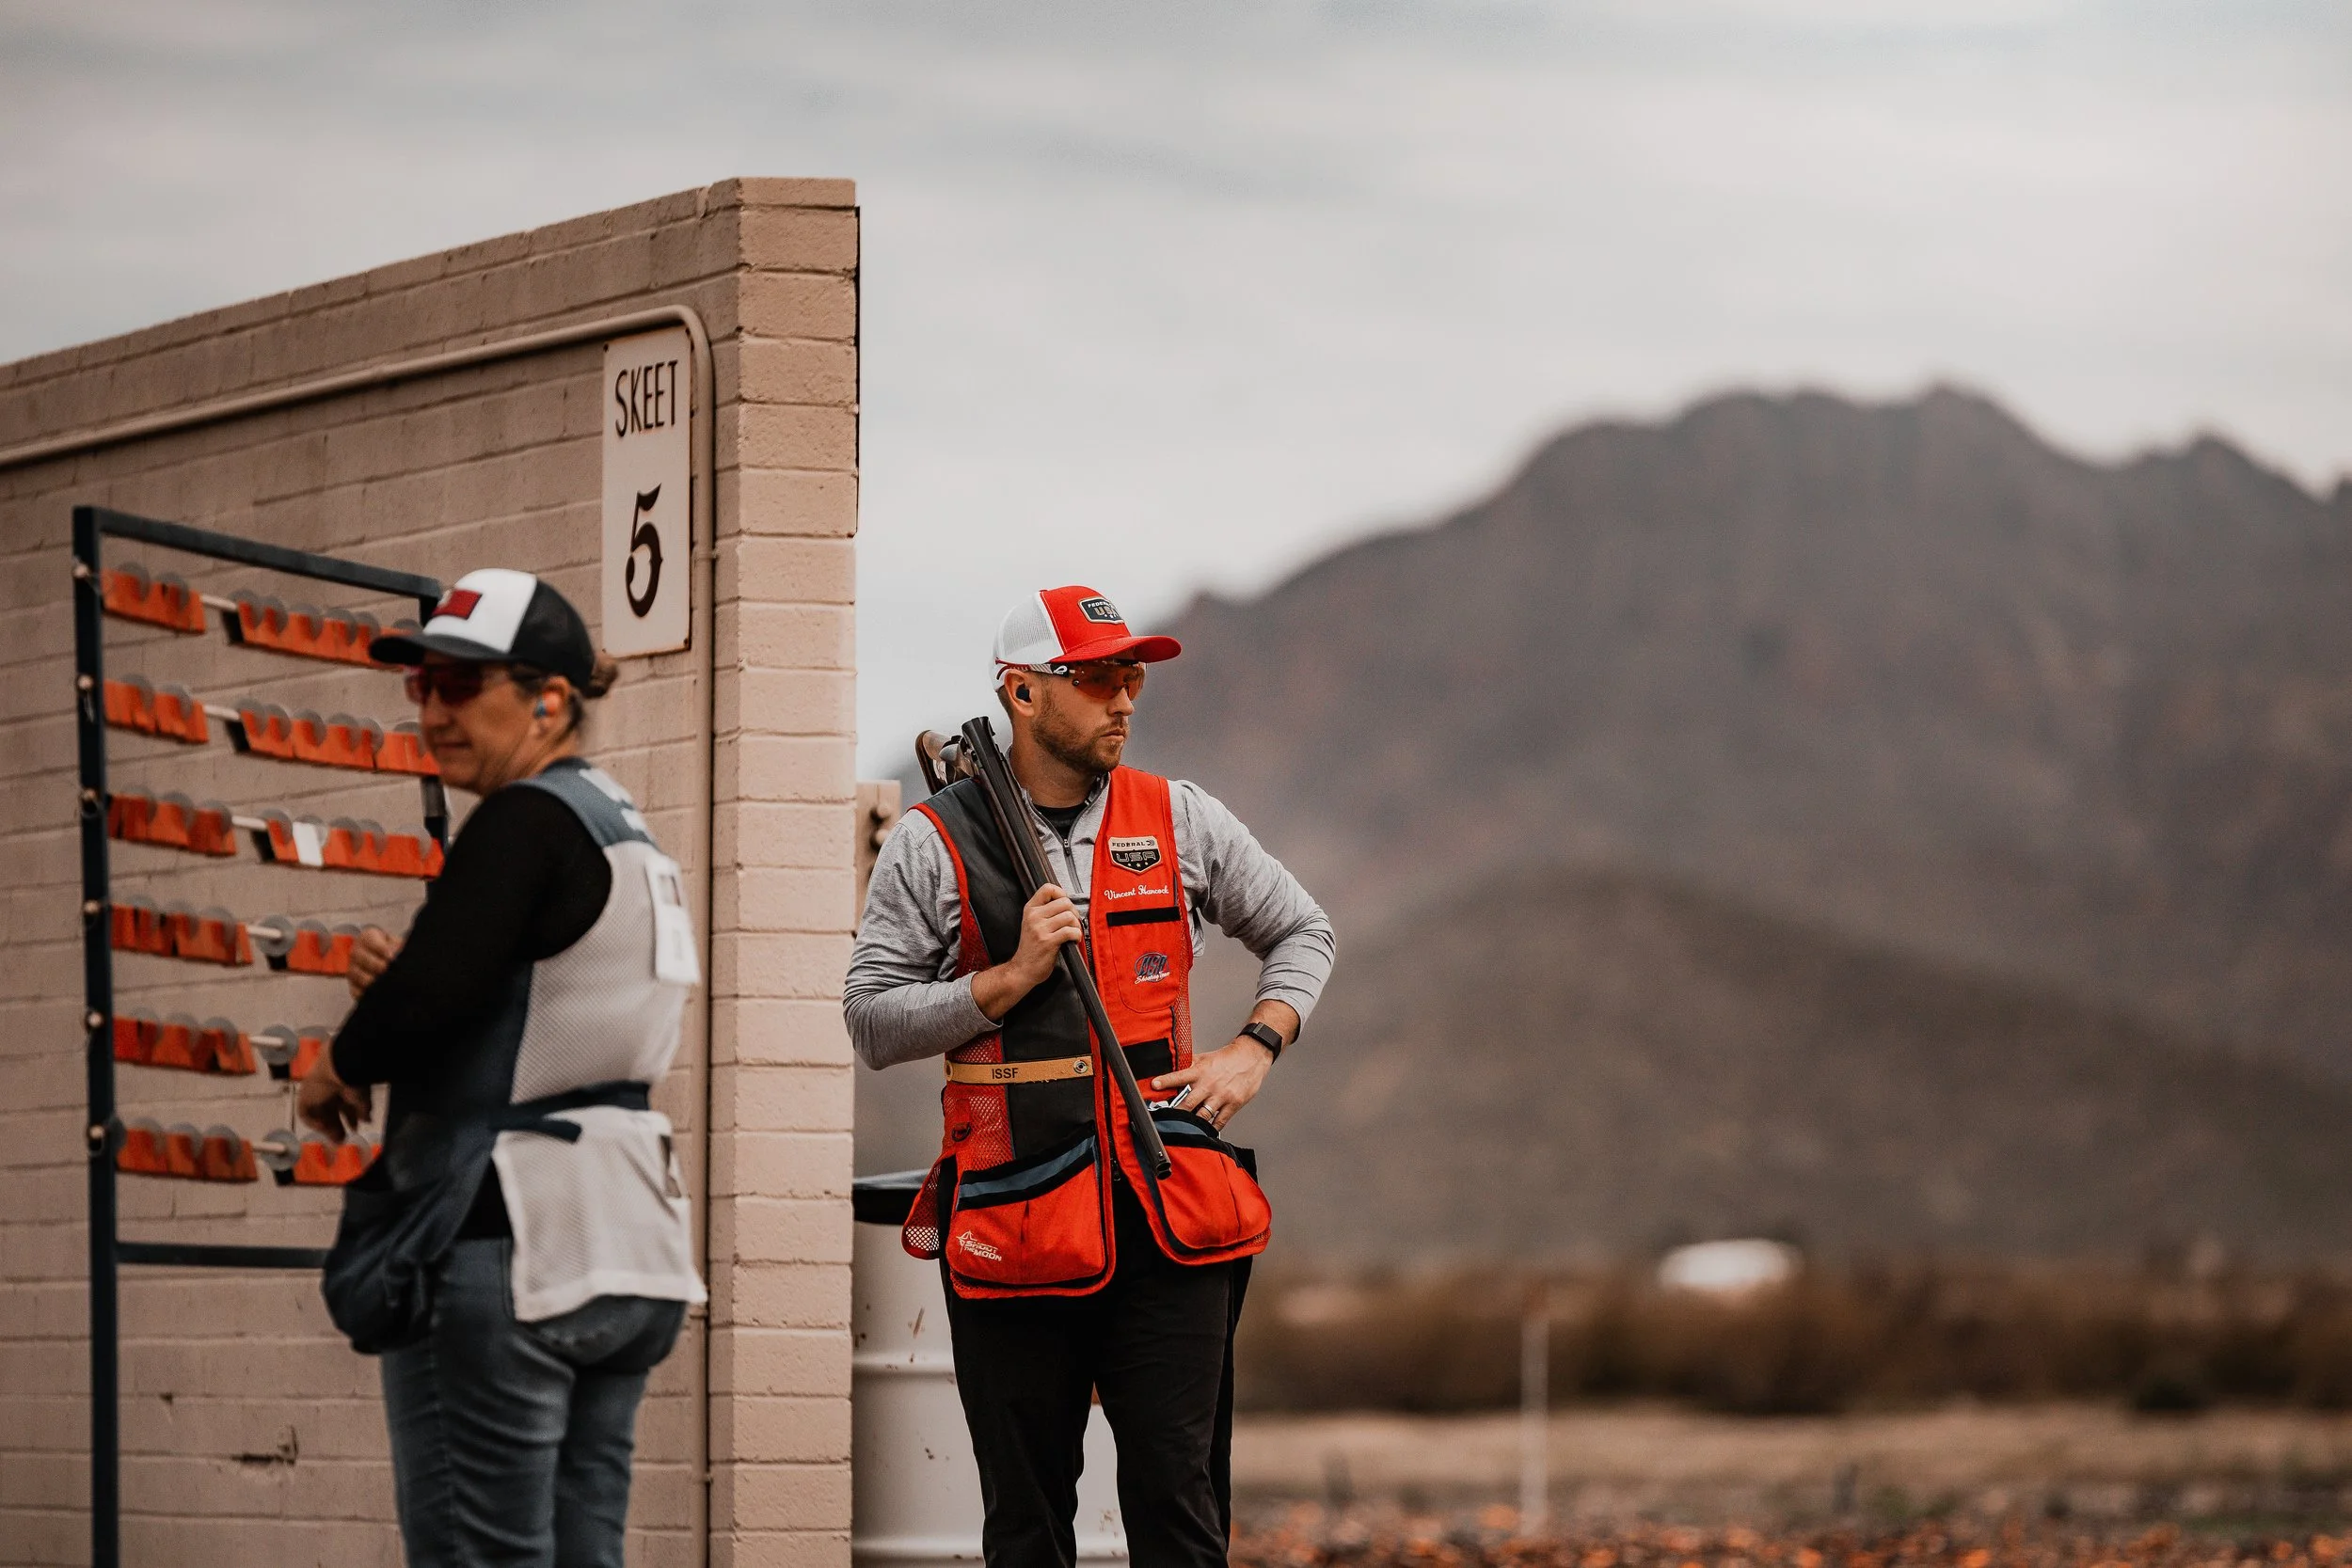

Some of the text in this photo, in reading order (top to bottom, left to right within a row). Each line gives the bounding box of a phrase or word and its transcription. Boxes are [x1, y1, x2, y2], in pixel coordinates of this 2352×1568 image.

[615, 359, 678, 437] SKEET
[625, 483, 663, 618] 5
[1116, 850, 1156, 863] USA
[1104, 884, 1169, 900] Vincent Hancock
[993, 1068, 1018, 1079] ISSF
[965, 1241, 998, 1253] SHOOT
[973, 1249, 1002, 1261] MOON
